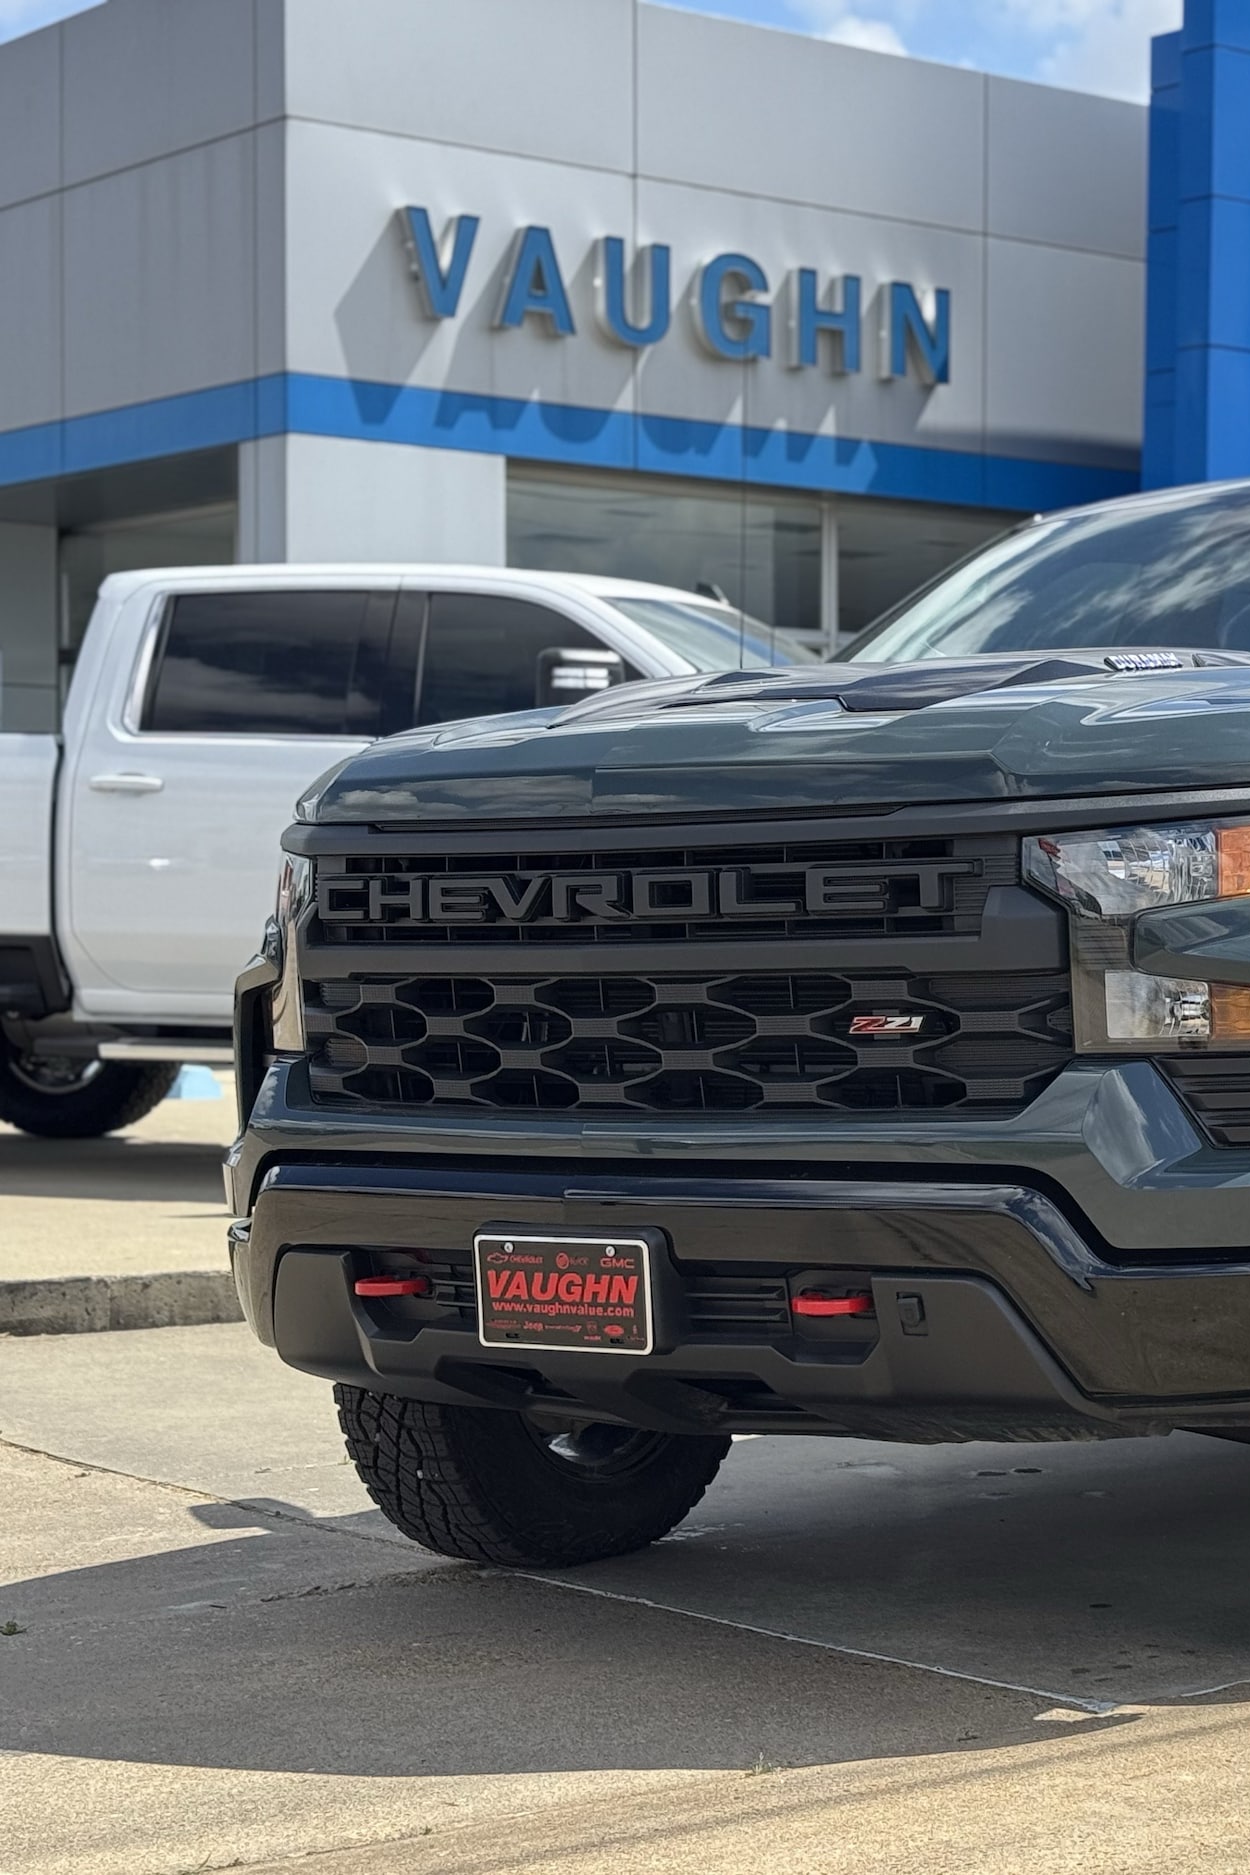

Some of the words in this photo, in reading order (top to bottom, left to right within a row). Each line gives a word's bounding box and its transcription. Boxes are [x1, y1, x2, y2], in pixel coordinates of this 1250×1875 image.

[400, 205, 951, 385] VAUGHN
[317, 858, 984, 923] CHEVROLET
[848, 1016, 924, 1034] Z71
[600, 1257, 635, 1269] GMC
[487, 1270, 638, 1304] VAUGHN
[492, 1301, 634, 1318] www.vaughnvalue.com
[523, 1320, 544, 1331] Jeep
